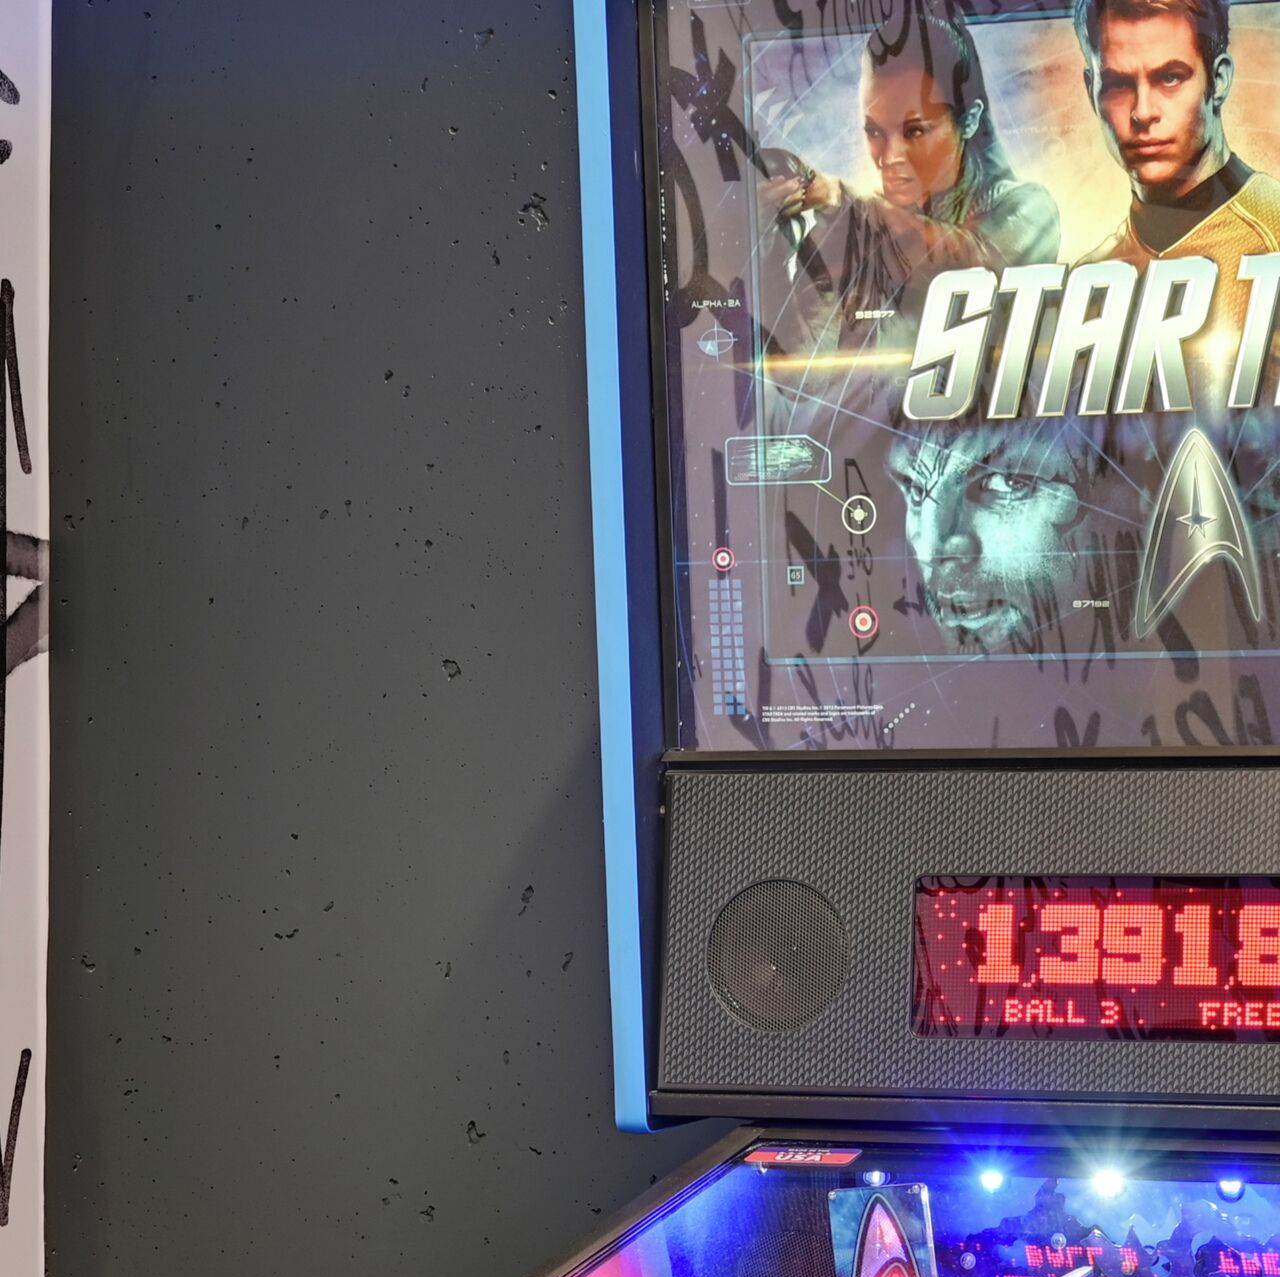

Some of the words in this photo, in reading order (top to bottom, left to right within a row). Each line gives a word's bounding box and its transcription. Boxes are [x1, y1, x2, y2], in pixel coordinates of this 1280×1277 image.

[902, 256, 1220, 420] STAR
[1003, 999, 1085, 1024] BALL
[1099, 999, 1120, 1025] 3
[774, 1152, 823, 1162] USA
